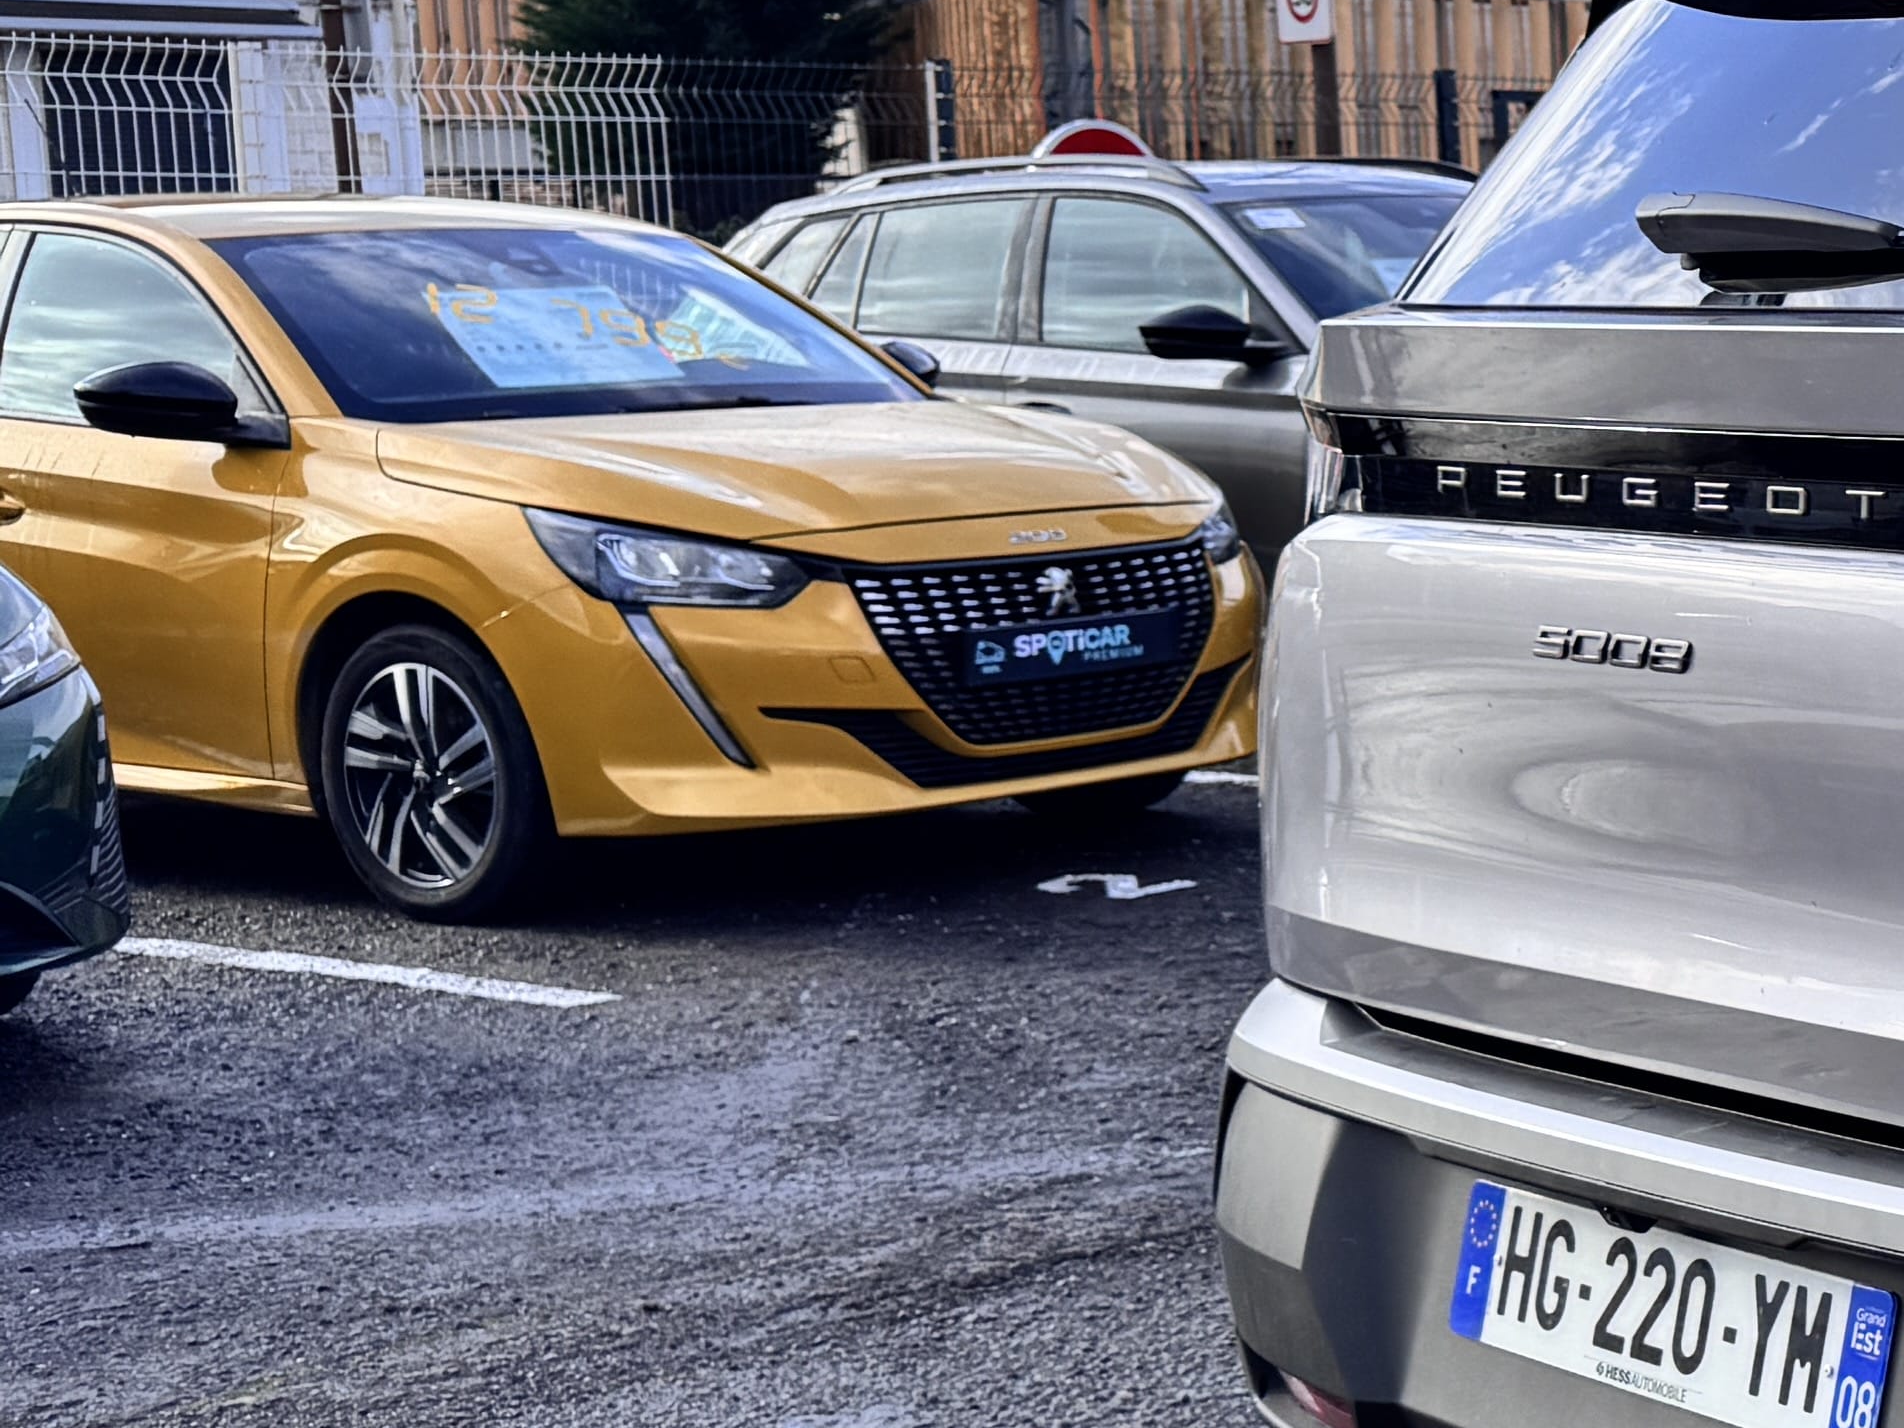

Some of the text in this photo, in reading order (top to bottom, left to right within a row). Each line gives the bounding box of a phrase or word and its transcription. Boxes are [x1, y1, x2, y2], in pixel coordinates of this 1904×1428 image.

[425, 281, 499, 325] 12
[1436, 464, 1887, 520] PEUGEOT
[1083, 644, 1145, 662] PREMIUM
[1533, 623, 1695, 674] 5008
[1465, 1264, 1482, 1296] F
[1496, 1204, 1834, 1415] HG-220-YM
[1855, 1307, 1888, 1329] Grand
[1851, 1321, 1884, 1357] Est
